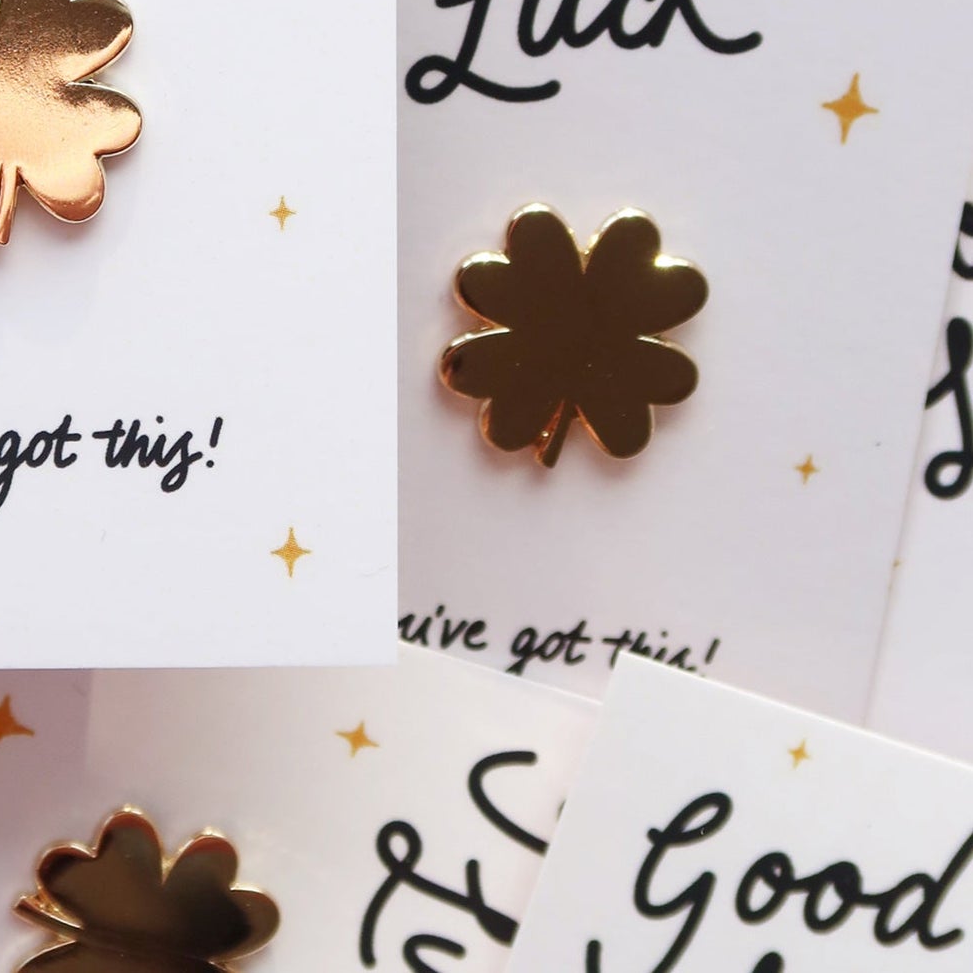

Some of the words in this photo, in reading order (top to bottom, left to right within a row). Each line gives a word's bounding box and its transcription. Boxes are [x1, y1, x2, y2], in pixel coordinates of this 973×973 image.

[91, 416, 224, 494] this!
[504, 618, 593, 676] got
[583, 791, 973, 973] Good
